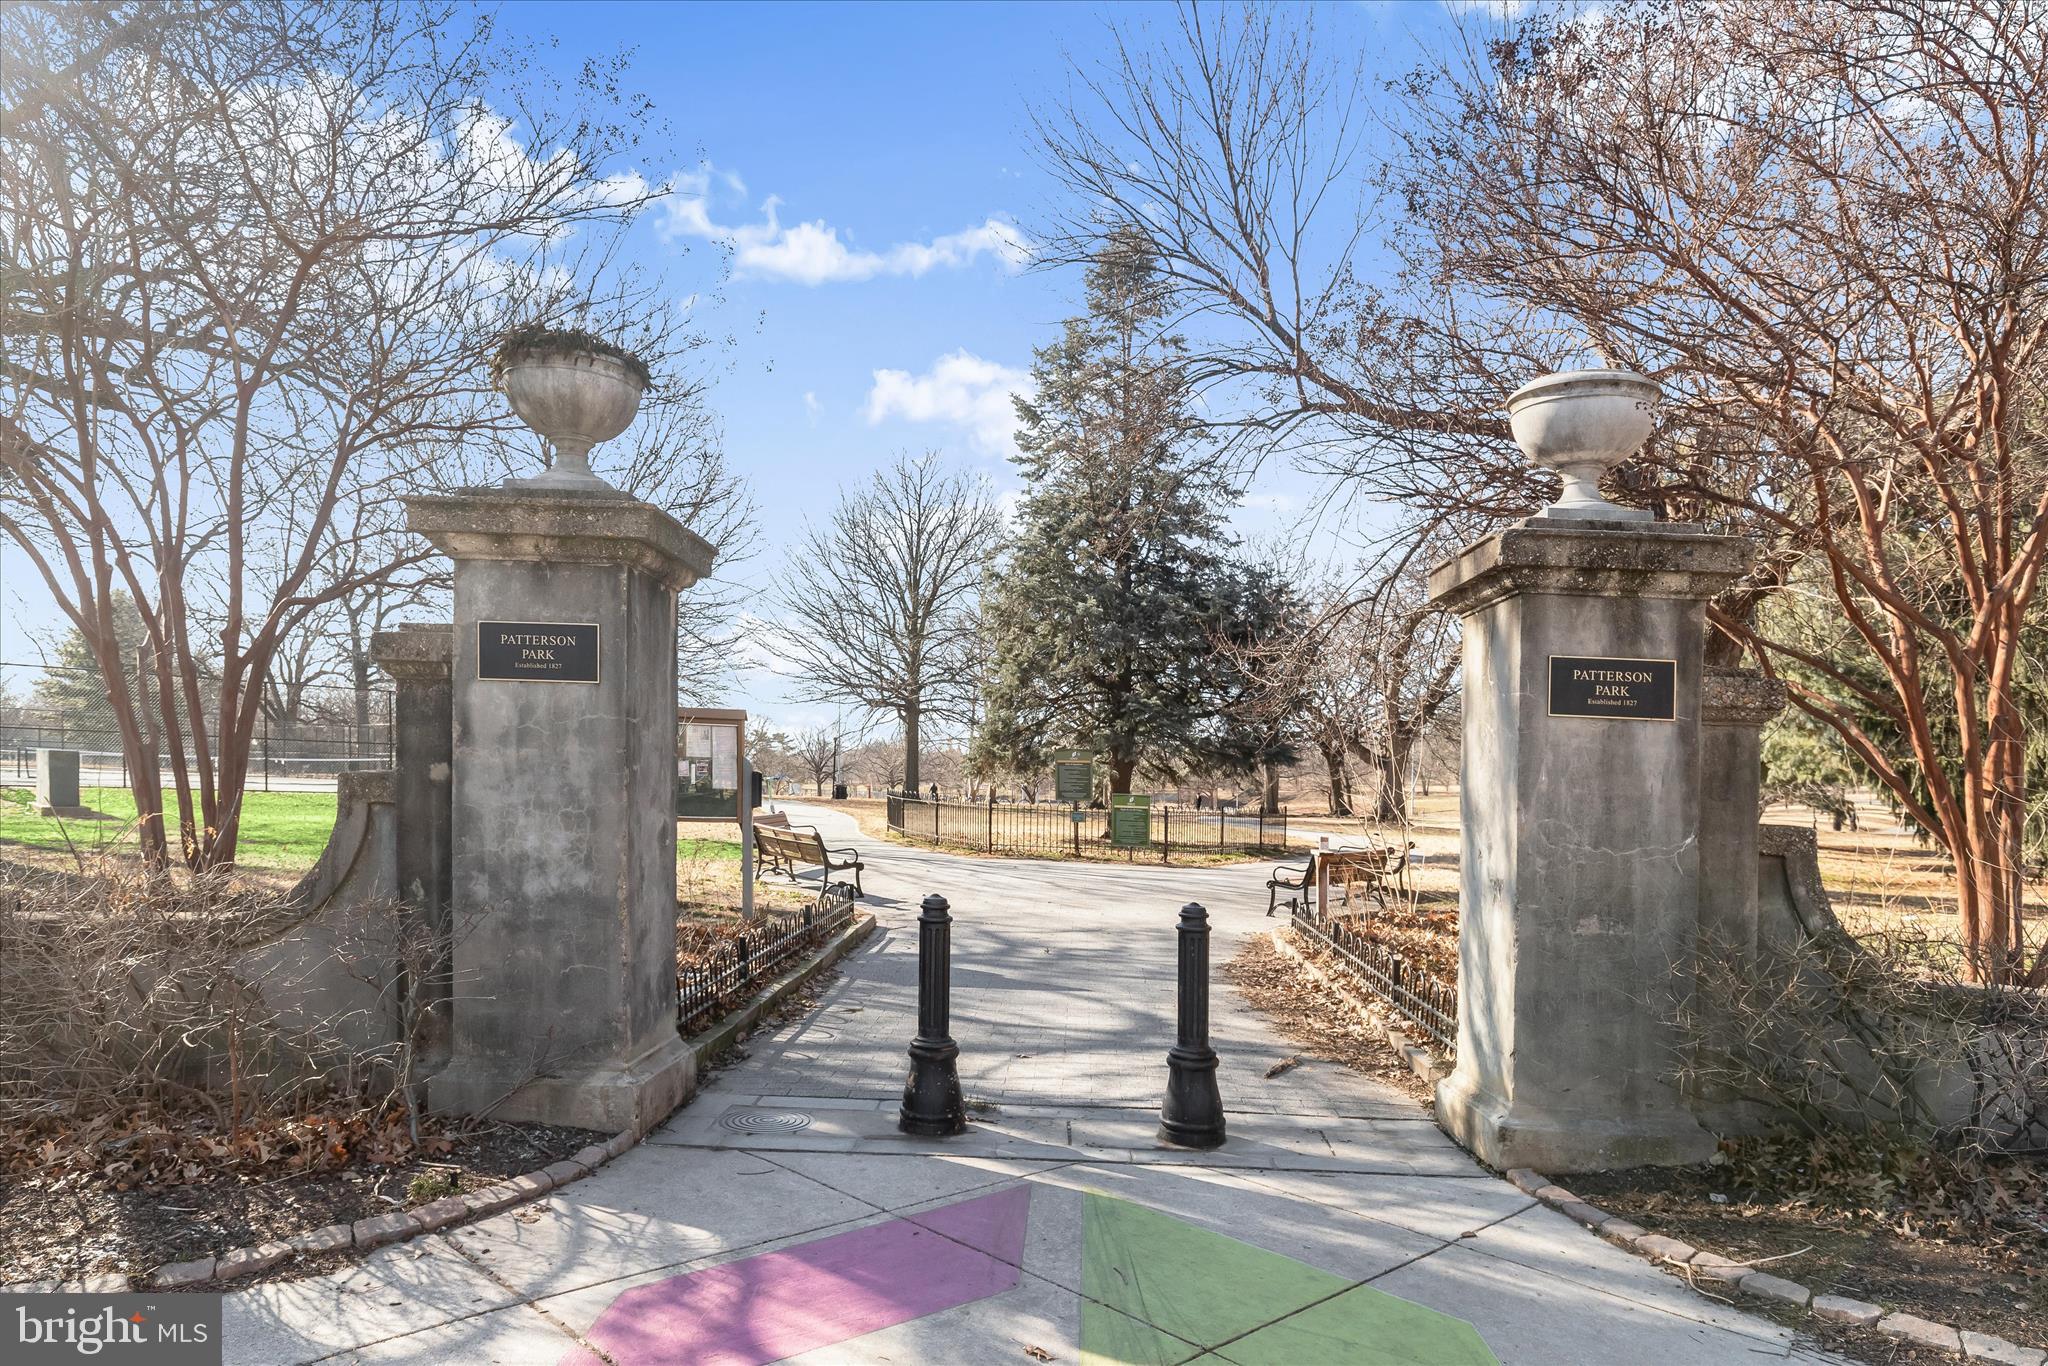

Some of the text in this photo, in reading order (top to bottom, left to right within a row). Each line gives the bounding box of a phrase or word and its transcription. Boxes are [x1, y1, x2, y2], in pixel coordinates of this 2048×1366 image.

[500, 634, 577, 647] PATTERSON
[522, 649, 555, 660] PARK
[514, 661, 547, 669] Established
[1573, 669, 1653, 683] PATTERSON
[1595, 685, 1630, 697] PARK
[1587, 698, 1638, 707] Established 1827
